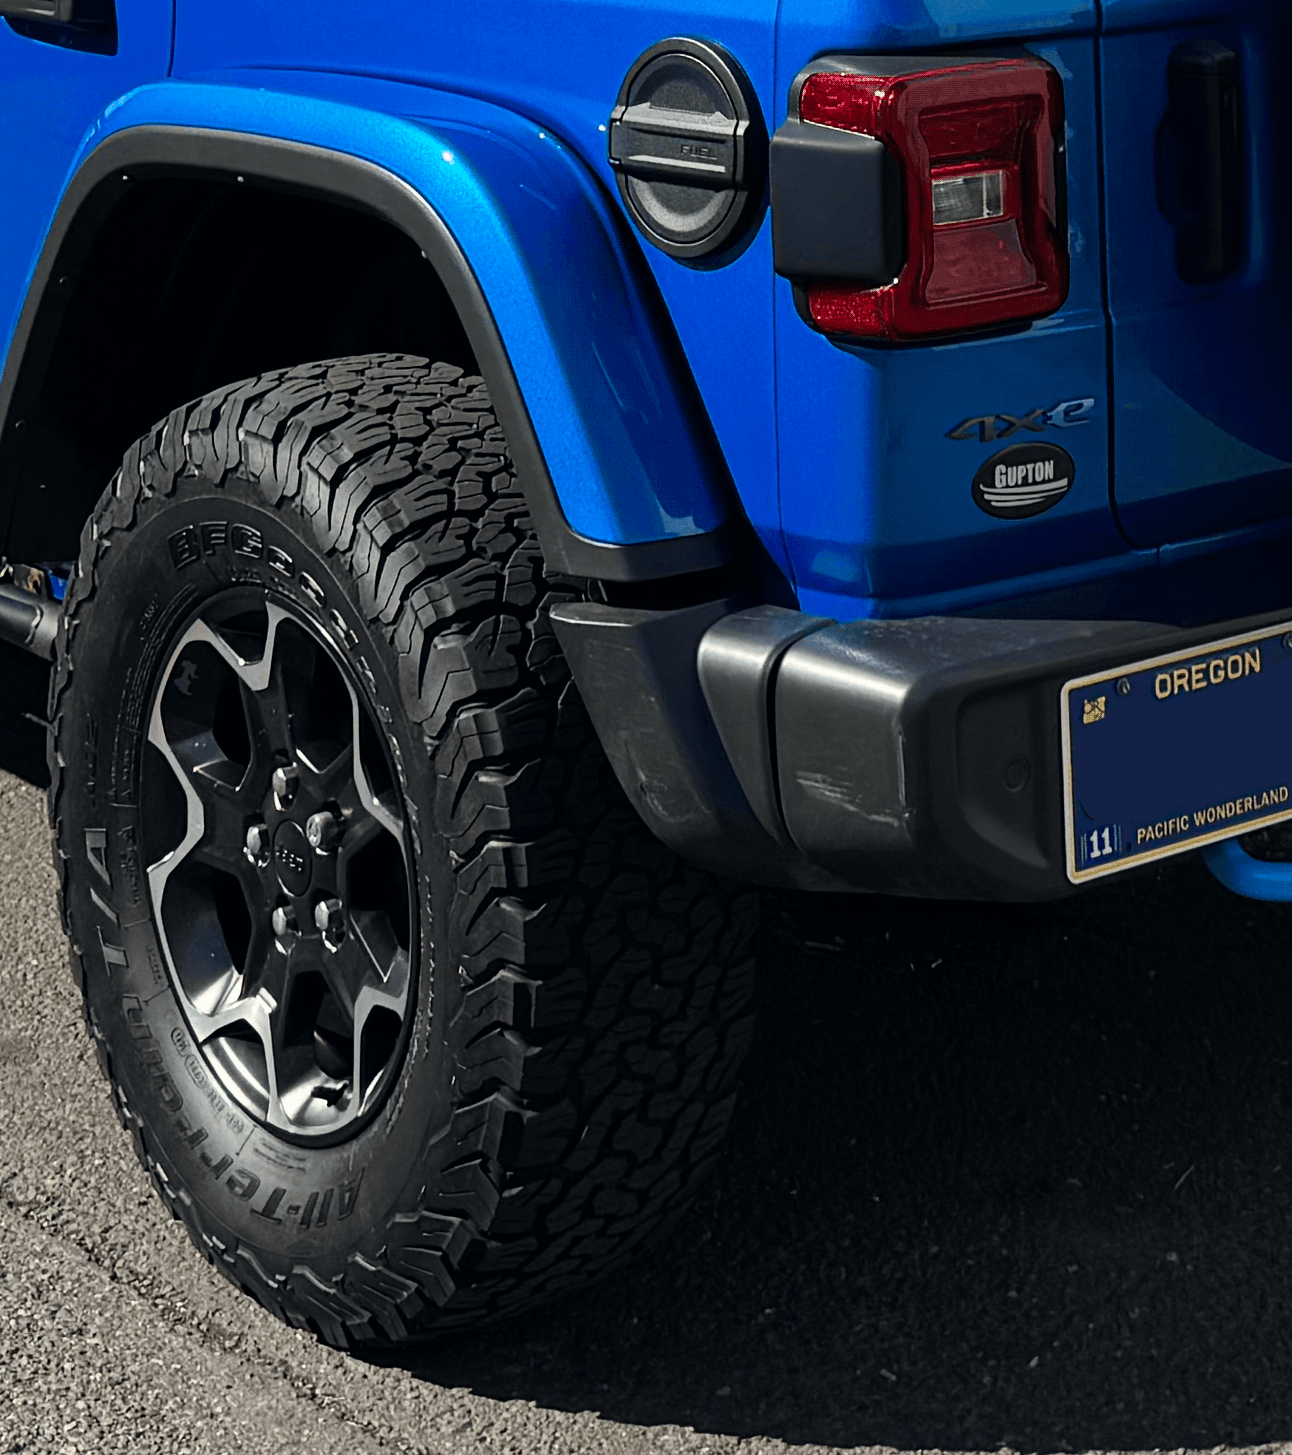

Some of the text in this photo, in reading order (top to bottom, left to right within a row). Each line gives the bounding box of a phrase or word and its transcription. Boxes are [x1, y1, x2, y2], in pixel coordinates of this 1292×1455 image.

[1155, 647, 1261, 699] OREGON
[1137, 786, 1289, 845] PACIFIC WONDERLAND
[1089, 827, 1113, 859] 11
